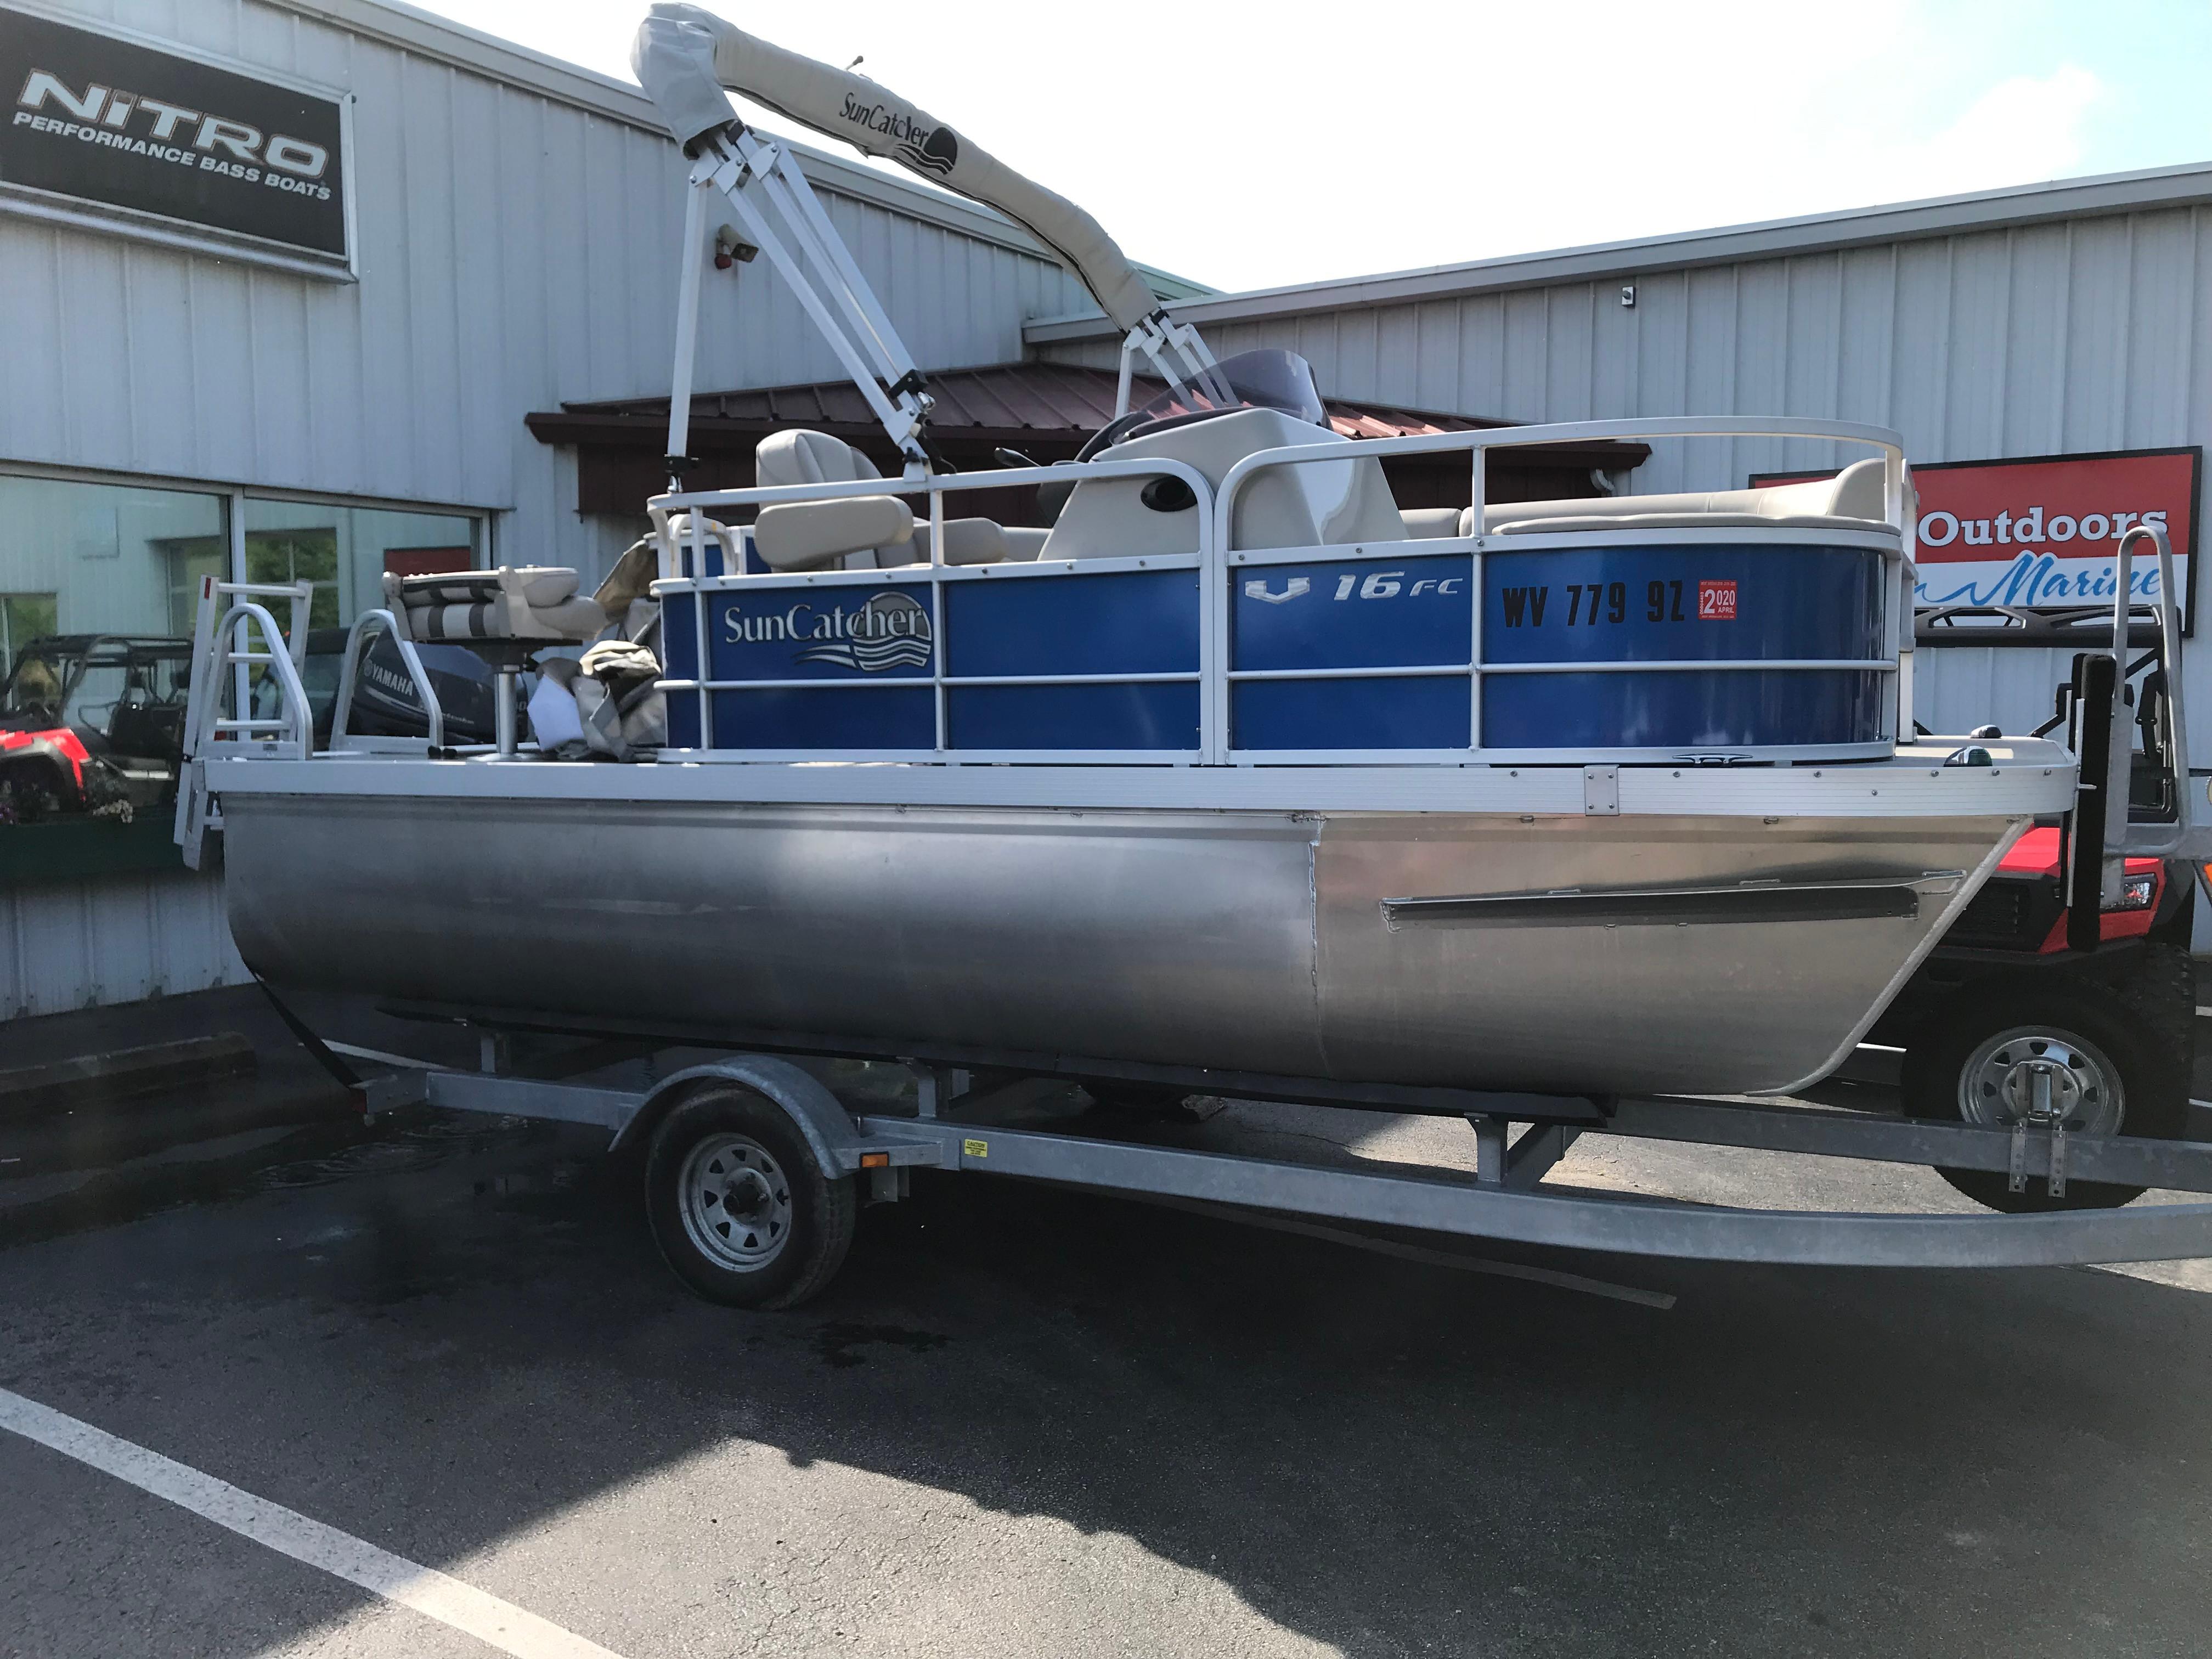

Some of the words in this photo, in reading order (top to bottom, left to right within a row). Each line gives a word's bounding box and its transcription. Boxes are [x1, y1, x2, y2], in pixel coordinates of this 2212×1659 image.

[13, 111, 196, 166] PERFORMANCE
[199, 156, 260, 183] BASS
[264, 173, 331, 201] BOATS
[1918, 506, 2168, 546] Outdoors
[1334, 571, 1406, 601] 16
[1409, 578, 1463, 597] FC
[1502, 586, 1549, 628] WV
[1567, 582, 1626, 627] 779
[1647, 580, 1685, 623] 9Z
[724, 601, 924, 643] SunCatcher
[373, 664, 413, 696] YAMAHA
